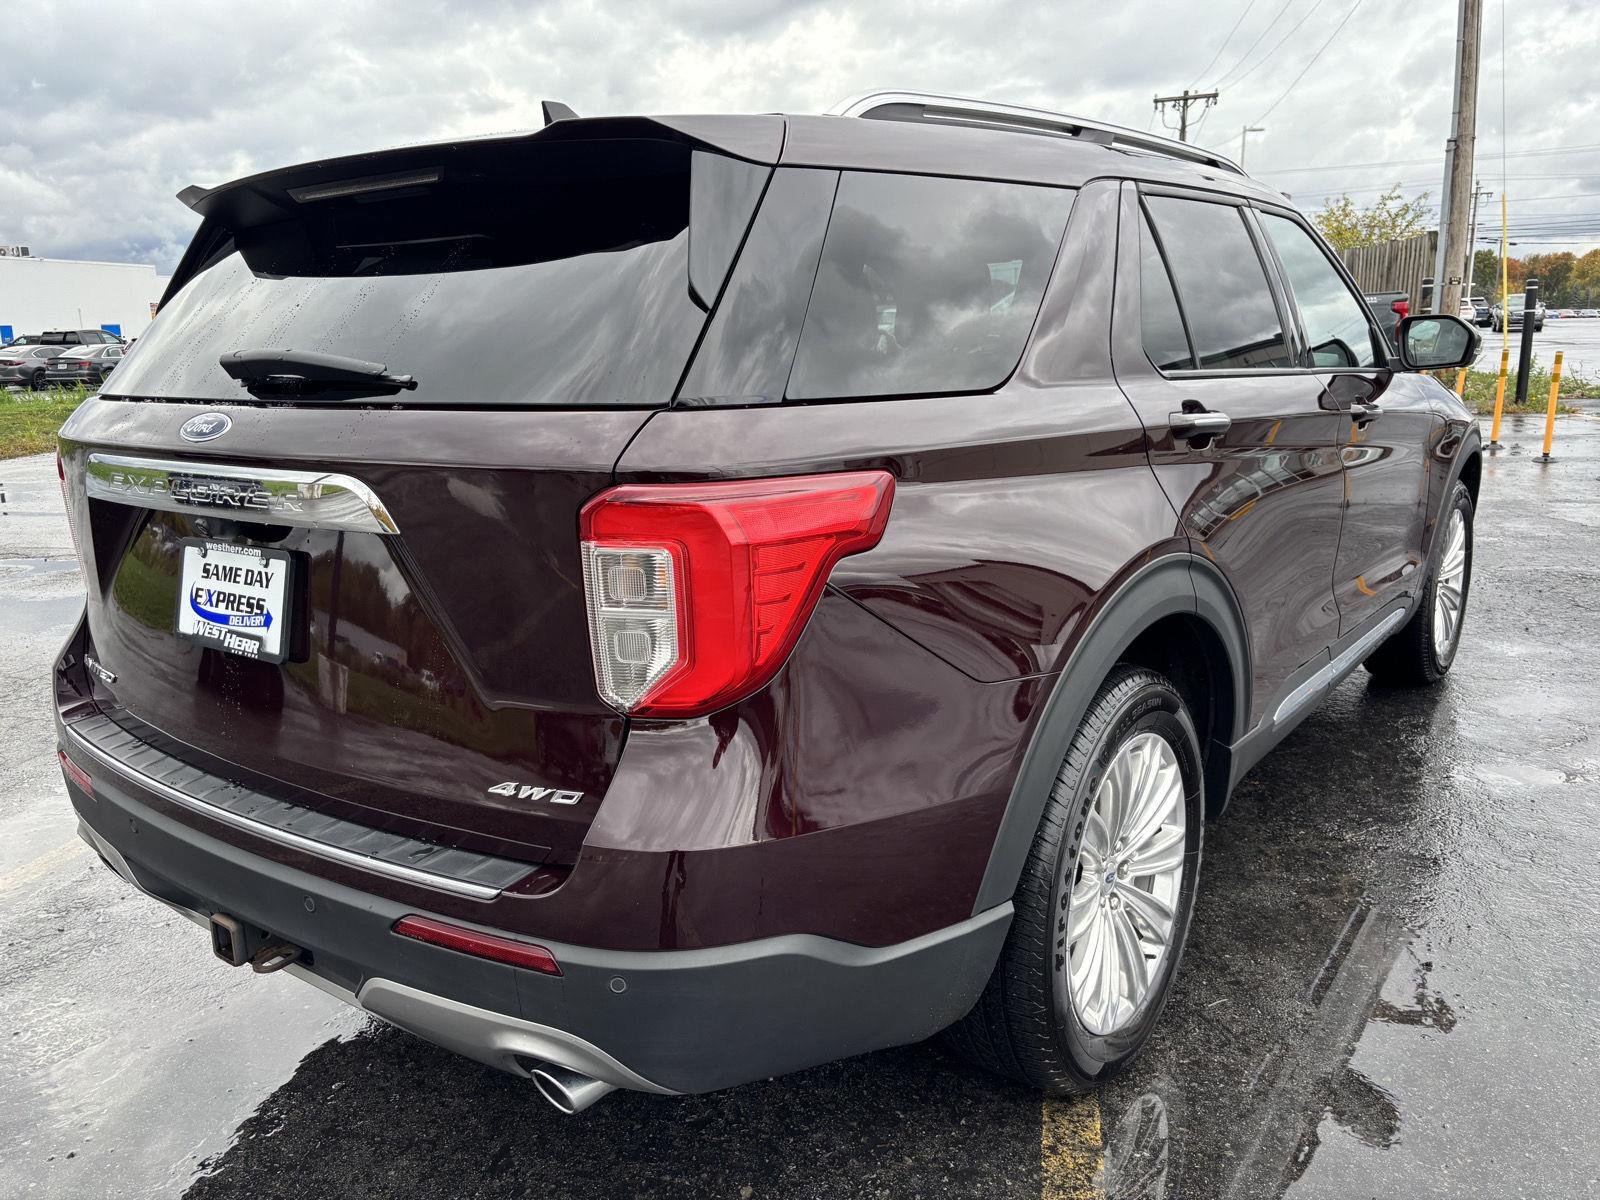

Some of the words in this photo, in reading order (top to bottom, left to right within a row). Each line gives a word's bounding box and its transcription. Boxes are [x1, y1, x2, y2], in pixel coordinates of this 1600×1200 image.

[109, 472, 304, 512] EXPLORER
[206, 542, 262, 557] westherr.com
[201, 562, 243, 584] SAME
[243, 568, 274, 589] DAY
[194, 587, 266, 615] EXPRESS
[229, 615, 266, 626] DELIVERY
[193, 620, 229, 640] WEST
[223, 632, 260, 654] HERR
[487, 781, 585, 806] 4WD
